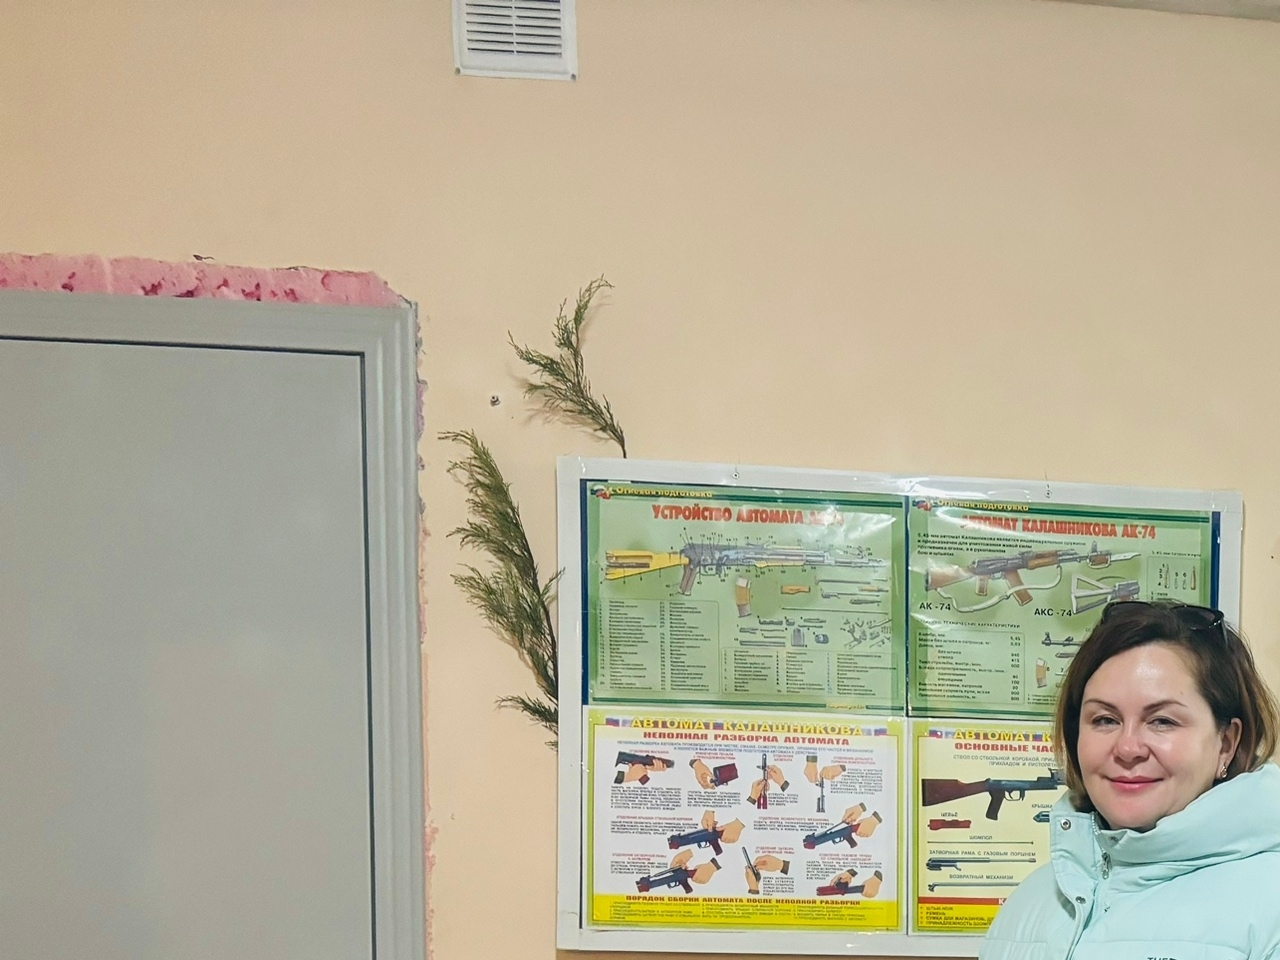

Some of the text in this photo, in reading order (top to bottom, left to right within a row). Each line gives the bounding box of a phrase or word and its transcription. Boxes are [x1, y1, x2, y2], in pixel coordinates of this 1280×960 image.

[652, 503, 732, 522] УСТРОЙСТВО
[736, 508, 803, 525] АВТОМАТА
[1021, 518, 1118, 539] КАЛАШНИКОВА
[1121, 524, 1157, 540] АК-74
[919, 602, 951, 612] АК -74
[1034, 607, 1055, 617] АКС
[631, 717, 864, 737] АВТОМАТ КАЛАШНИКОВА
[643, 731, 850, 746] НЕПОЛНАЯ РАЗБОРКА АВТОМАТА
[953, 729, 1034, 742] АВТОМАТ
[955, 742, 1029, 753] ОСНОВНЫЕ
